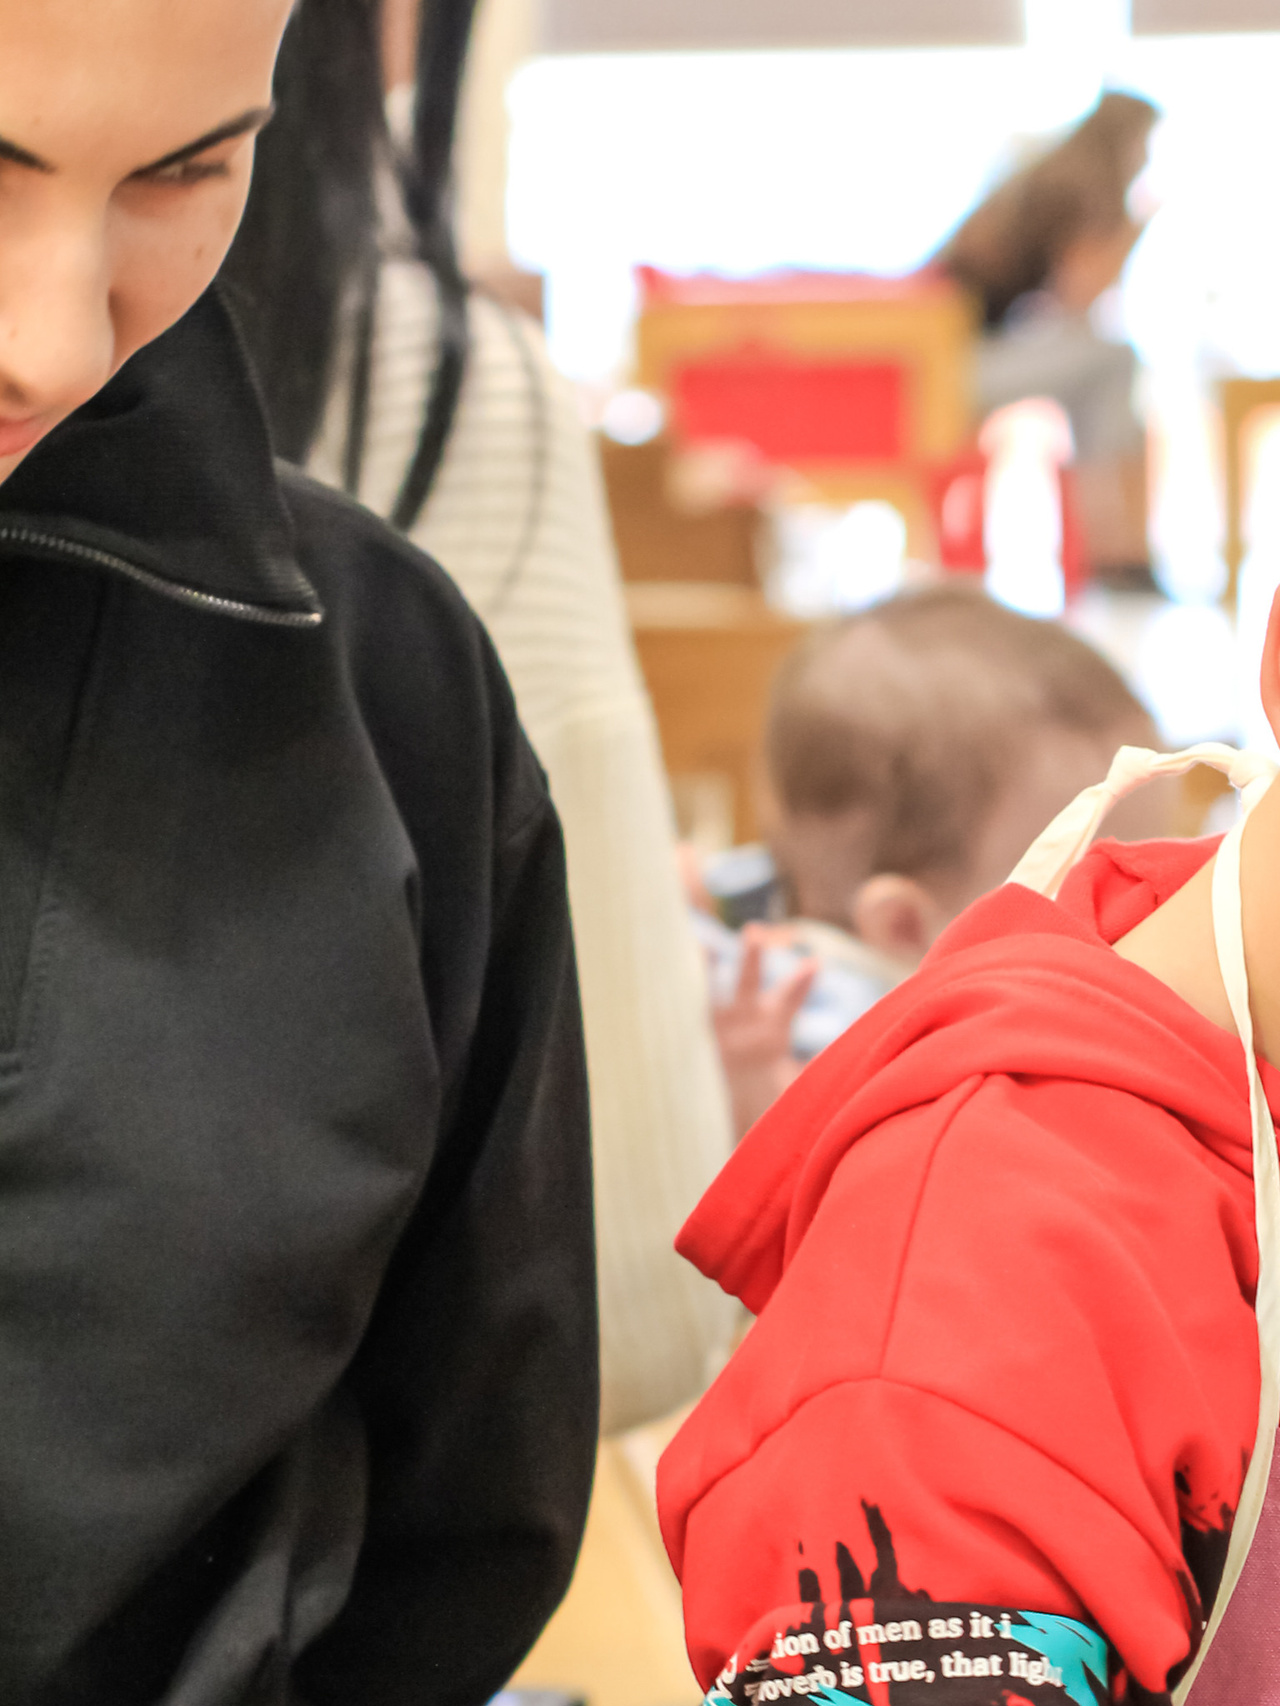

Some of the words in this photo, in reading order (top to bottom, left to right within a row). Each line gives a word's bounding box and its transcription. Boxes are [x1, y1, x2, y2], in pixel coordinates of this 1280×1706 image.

[823, 1620, 853, 1650] of
[856, 1621, 920, 1645] men
[927, 1615, 964, 1640] as
[968, 1610, 996, 1639] it
[840, 1661, 864, 1688] is
[868, 1657, 936, 1683] true,
[940, 1650, 1003, 1678] that
